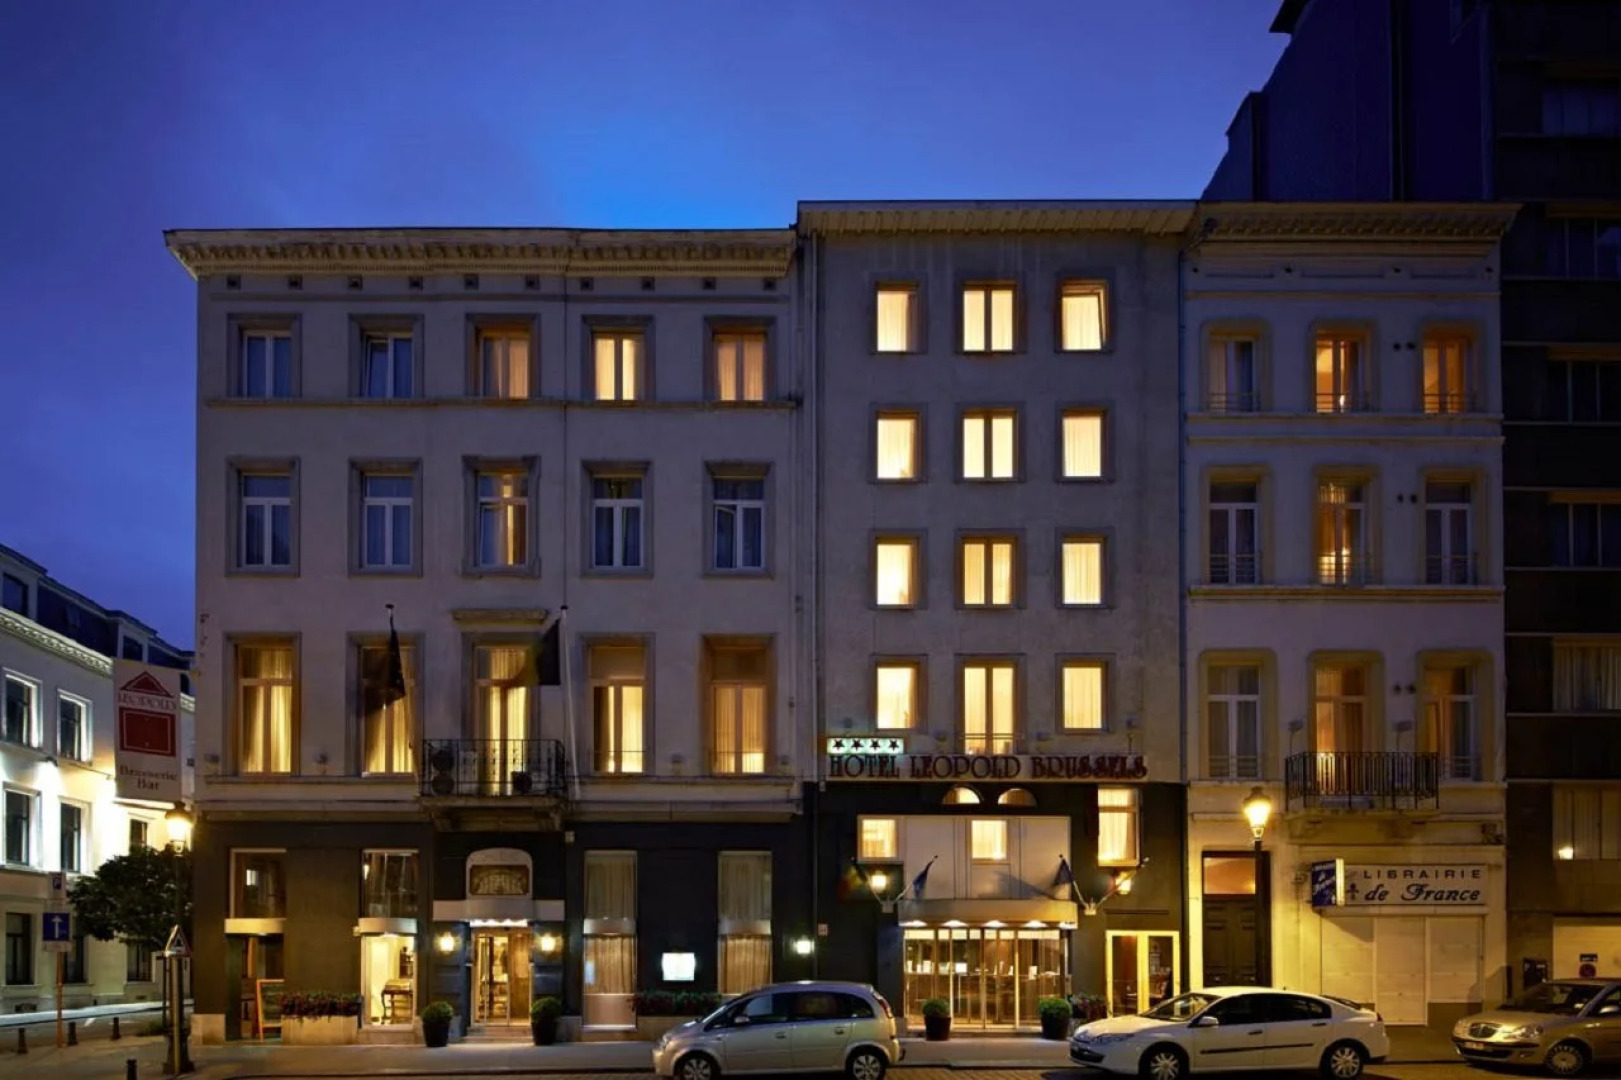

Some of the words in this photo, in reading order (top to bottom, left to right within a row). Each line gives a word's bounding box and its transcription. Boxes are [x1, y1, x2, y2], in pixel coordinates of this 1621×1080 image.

[829, 755, 900, 778] HOTEL
[909, 755, 1021, 778] LEOPOLD
[1031, 754, 1148, 779] BRUSSELS
[137, 777, 159, 791] Bar
[1363, 869, 1481, 880] LIBRAIRIE
[1364, 883, 1390, 901] de
[1401, 883, 1481, 901] France
